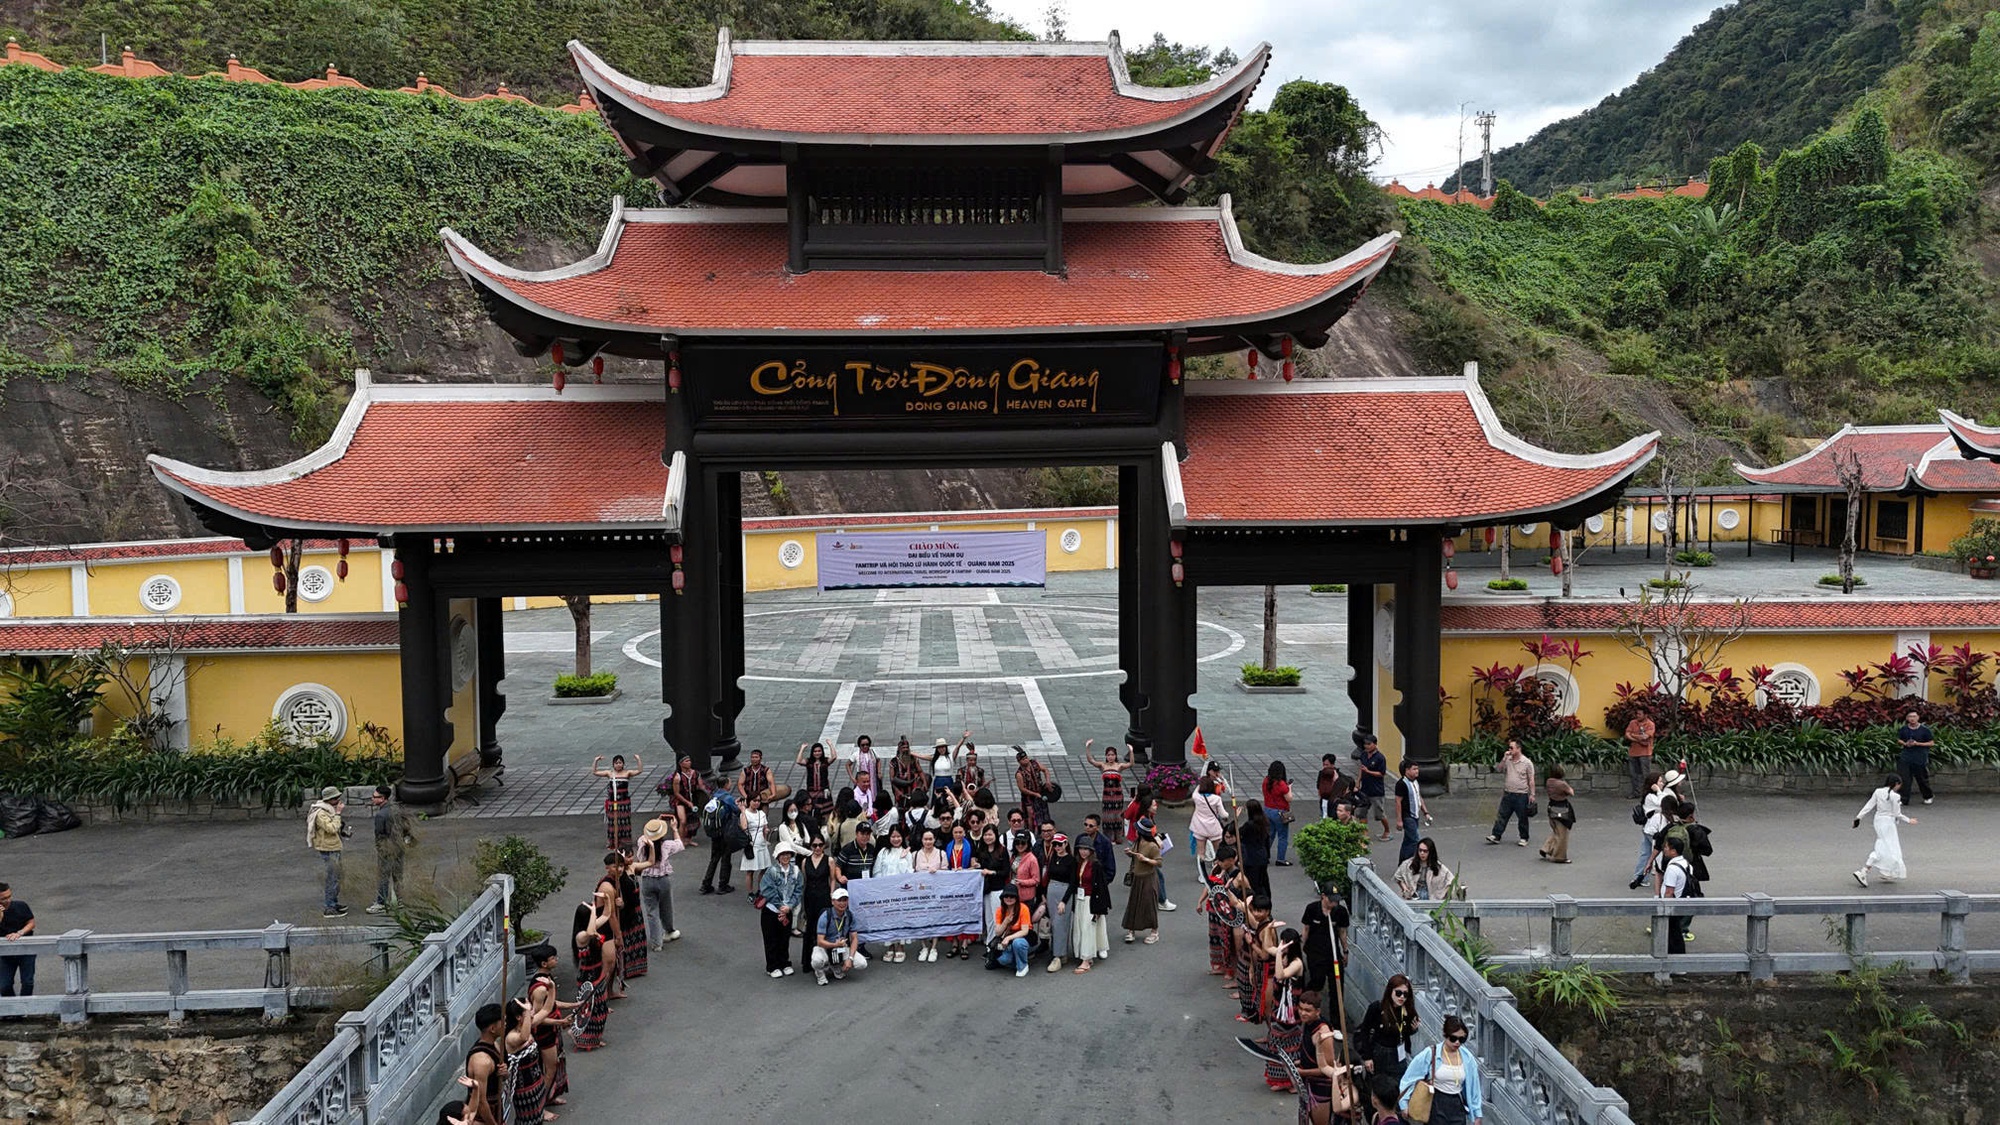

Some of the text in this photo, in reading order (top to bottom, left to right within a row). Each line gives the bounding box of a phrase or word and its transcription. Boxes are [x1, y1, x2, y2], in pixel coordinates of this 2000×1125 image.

[750, 358, 1099, 416] Cổng Trời Đông Giang
[905, 399, 1088, 411] DONG GIANG HEAVEN GATE
[909, 542, 934, 550] CHÀO
